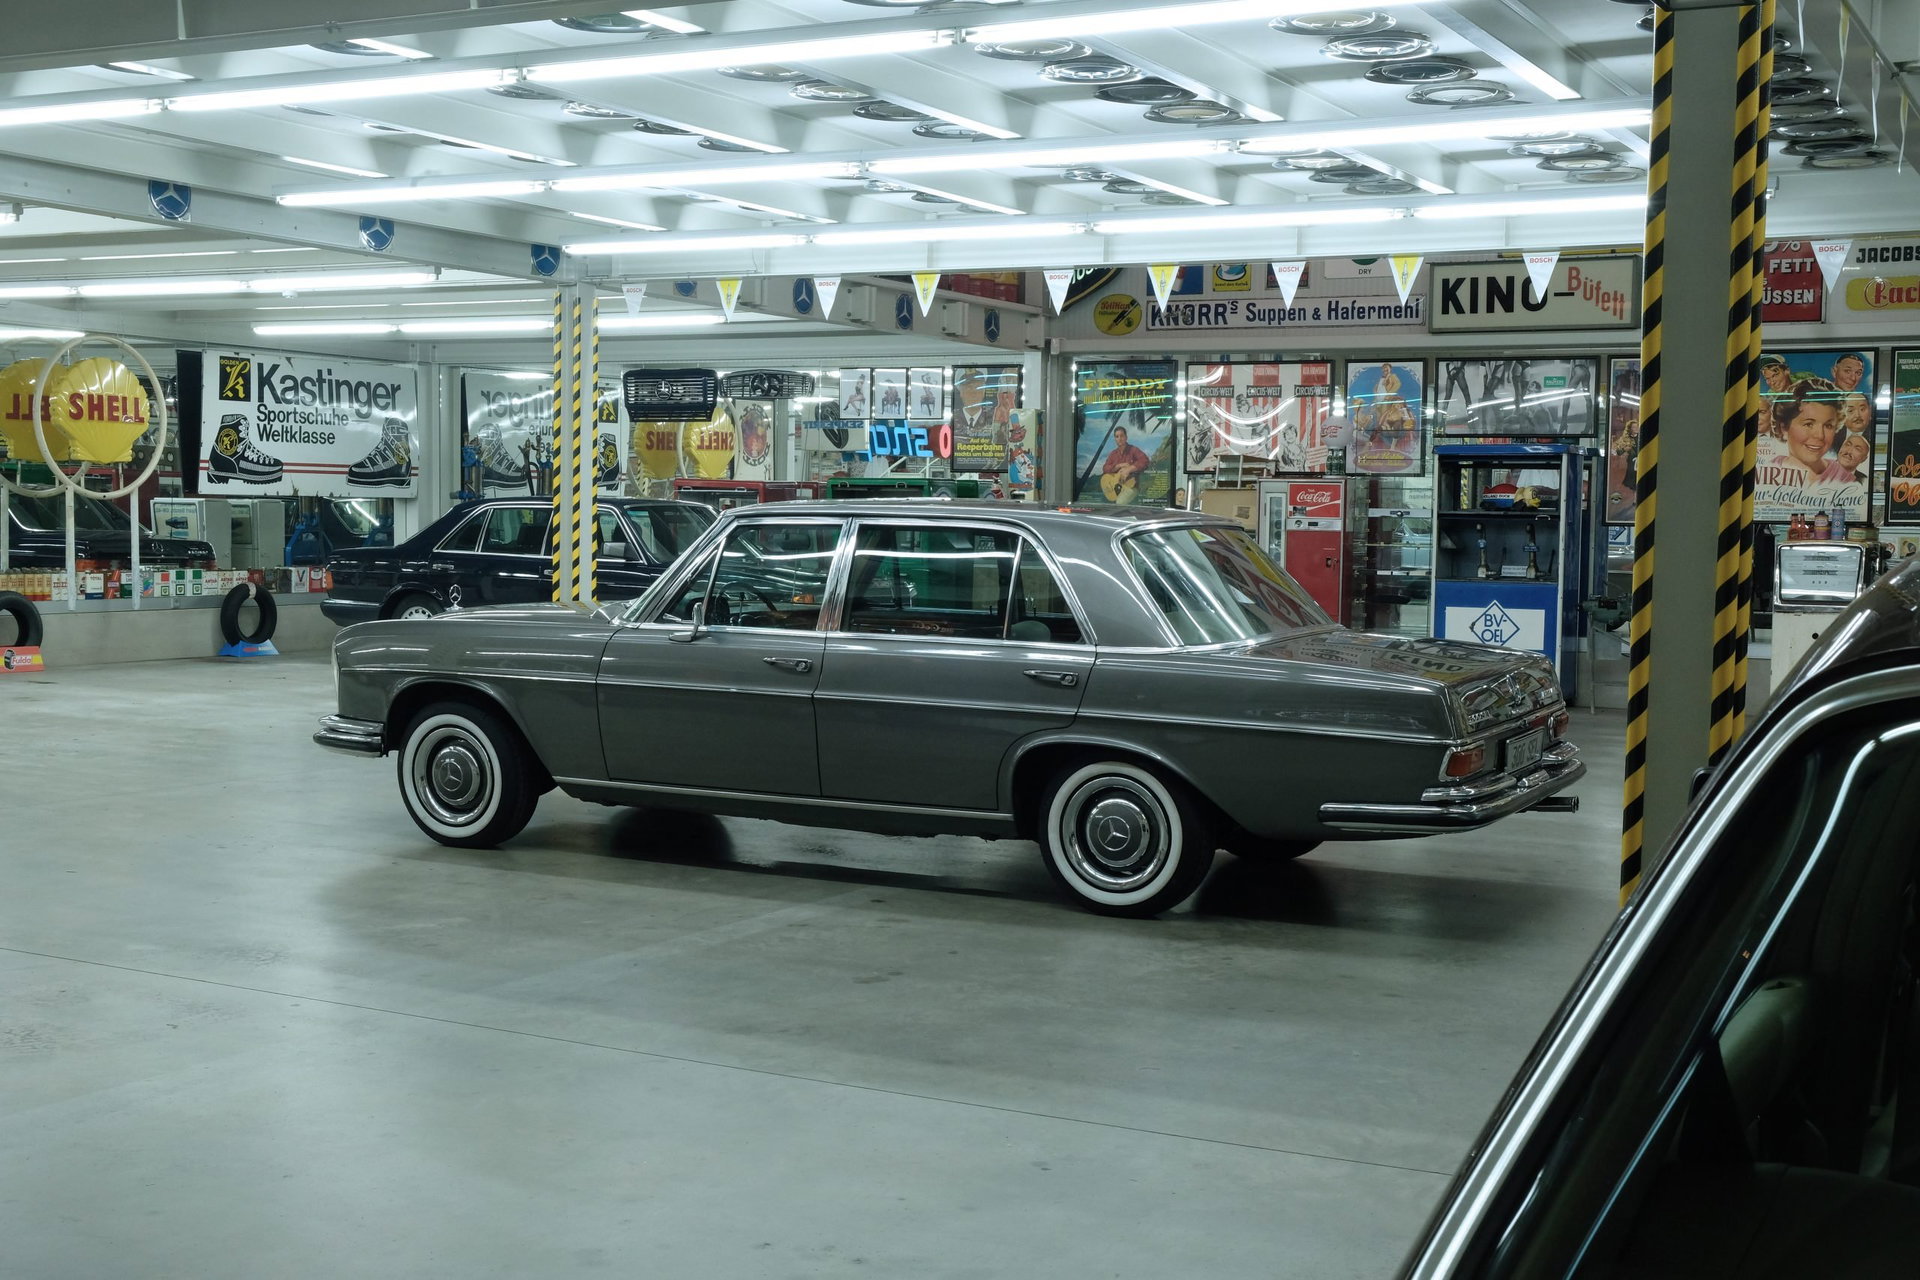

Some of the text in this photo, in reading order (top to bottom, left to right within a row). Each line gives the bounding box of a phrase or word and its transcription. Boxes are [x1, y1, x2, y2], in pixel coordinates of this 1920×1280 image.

[1530, 256, 1553, 264] BOSCH
[1769, 258, 1814, 273] FETT
[1567, 266, 1625, 320] Büfett
[1762, 287, 1814, 304] ÜSSEN
[1246, 302, 1306, 325] Suppen
[1312, 307, 1321, 320] &
[1328, 298, 1420, 320] Hafermehl
[257, 362, 401, 420] Kastinger
[1084, 378, 1168, 390] FREDDY
[68, 392, 145, 424] SHELL
[256, 403, 349, 427] Sportschuhe
[256, 424, 336, 445] Weltklasse
[956, 443, 1003, 452] Reeperbahn
[1296, 491, 1332, 503] Coca-Cola
[1819, 485, 1865, 507] Krone
[1484, 614, 1507, 628] BV-
[1481, 628, 1504, 643] OEL
[12, 656, 32, 664] Fulda
